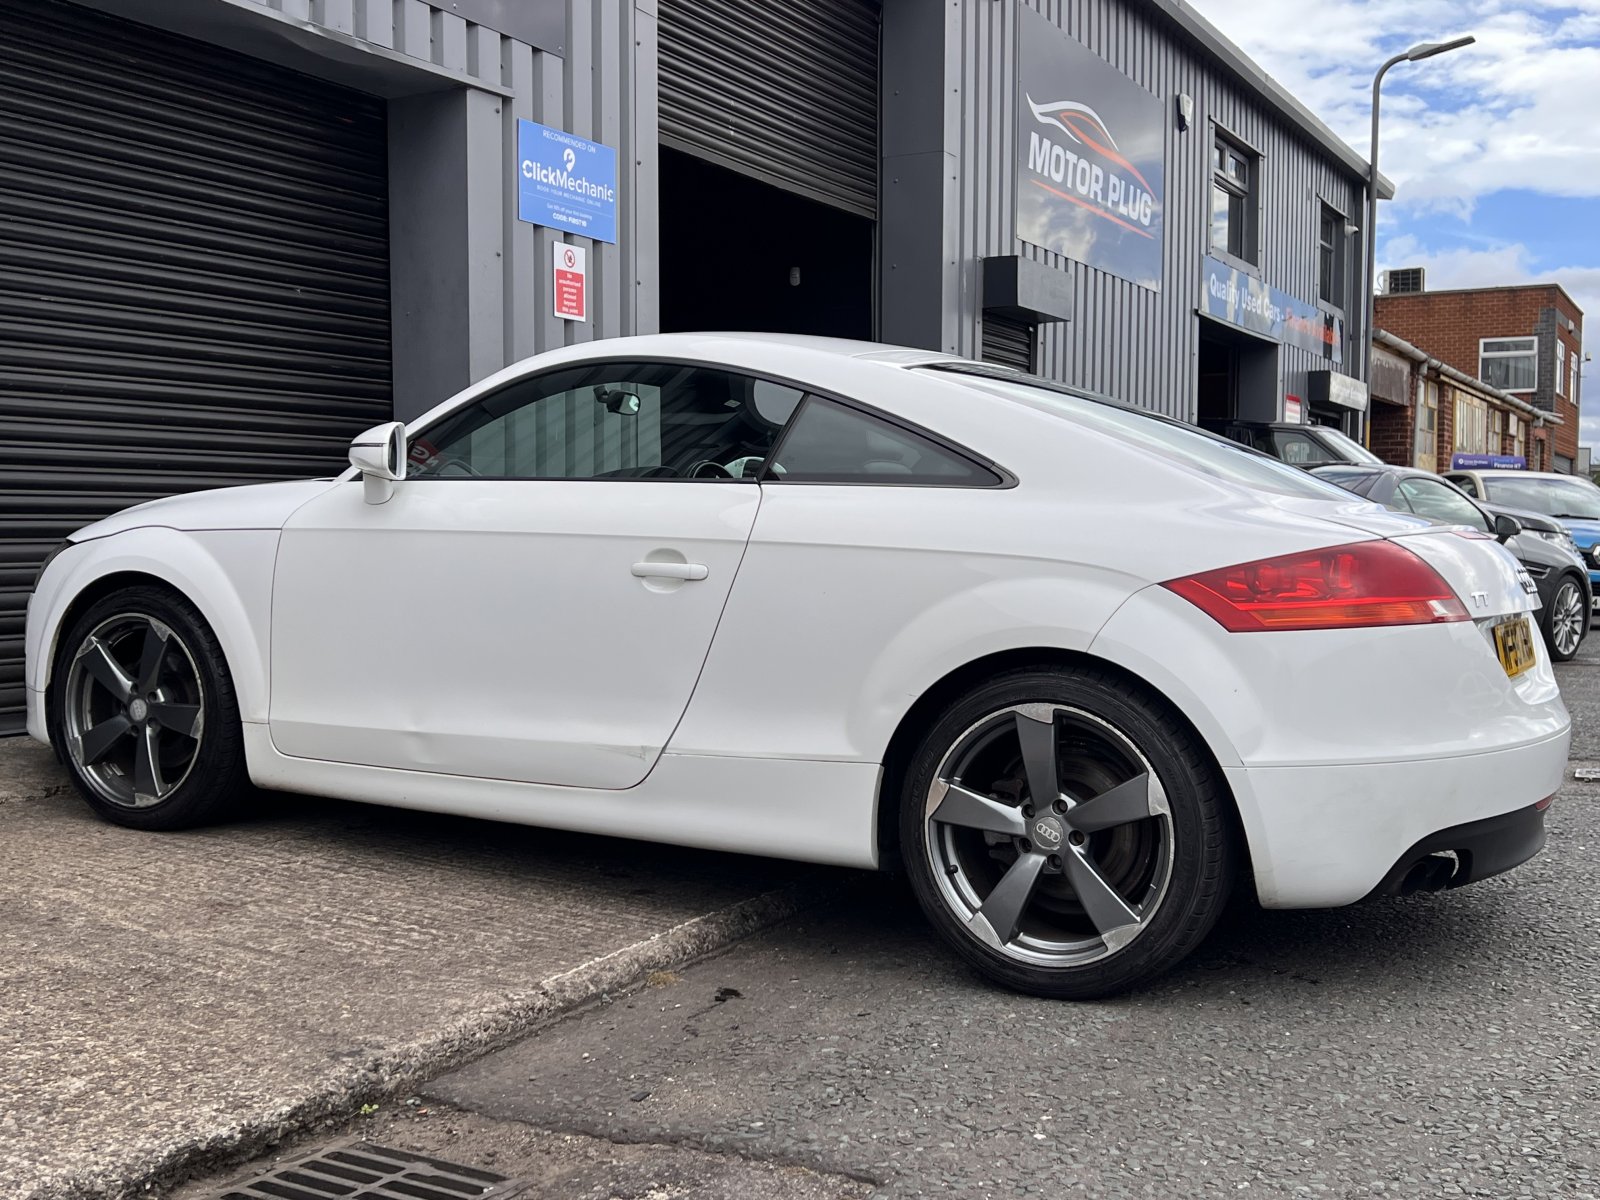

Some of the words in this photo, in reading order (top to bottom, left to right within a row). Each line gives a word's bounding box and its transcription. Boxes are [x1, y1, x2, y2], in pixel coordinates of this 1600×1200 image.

[543, 130, 587, 151] RECOMMENDED
[588, 145, 596, 153] ON
[1028, 131, 1104, 203] MOTOR
[1107, 174, 1152, 226] PLUG
[563, 191, 586, 203] MECHANIC
[1210, 272, 1240, 310] Quality
[1241, 287, 1262, 314] Used
[1264, 297, 1281, 322] Cars
[1470, 591, 1489, 609] TT
